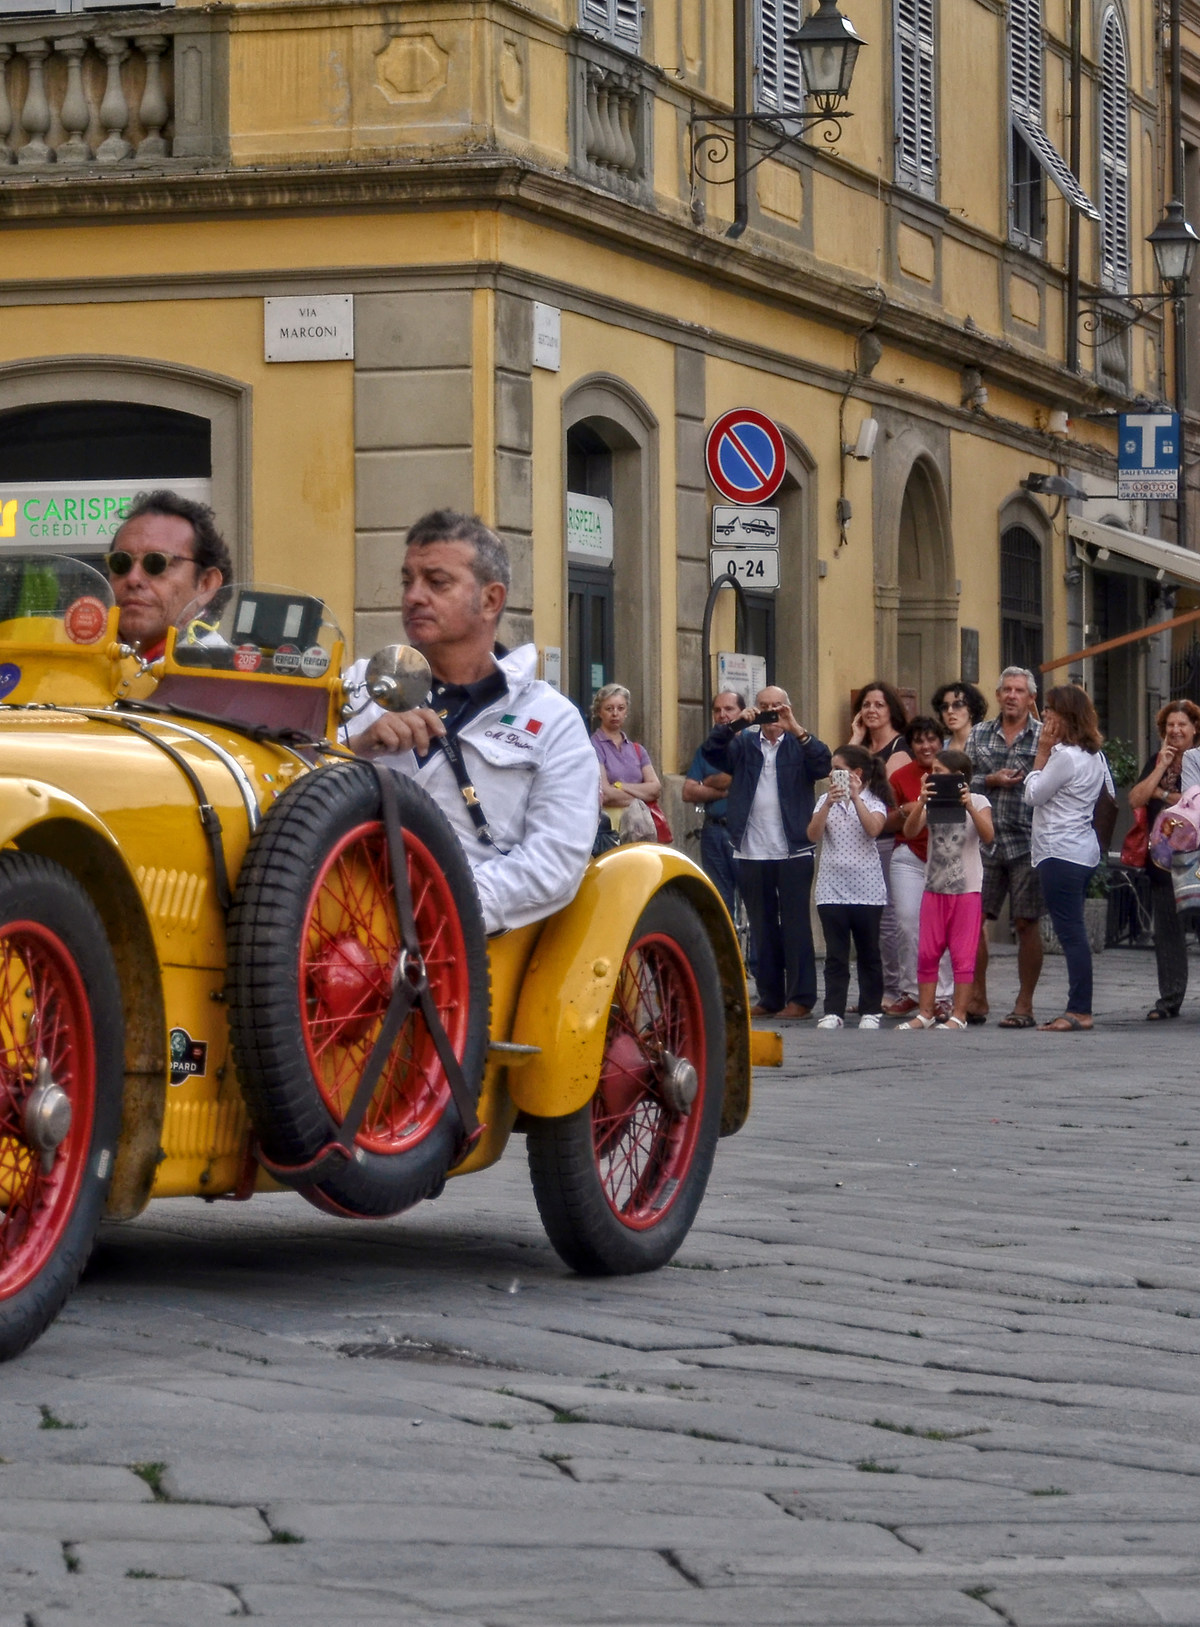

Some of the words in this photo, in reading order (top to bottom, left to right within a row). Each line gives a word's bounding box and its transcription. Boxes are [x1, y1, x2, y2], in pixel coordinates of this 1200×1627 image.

[299, 308, 317, 317] VIA
[280, 326, 337, 338] MARCONI
[1126, 414, 1173, 468] T
[29, 522, 88, 537] CRÉDIT
[727, 559, 765, 577] 0-24
[238, 654, 257, 665] 2015
